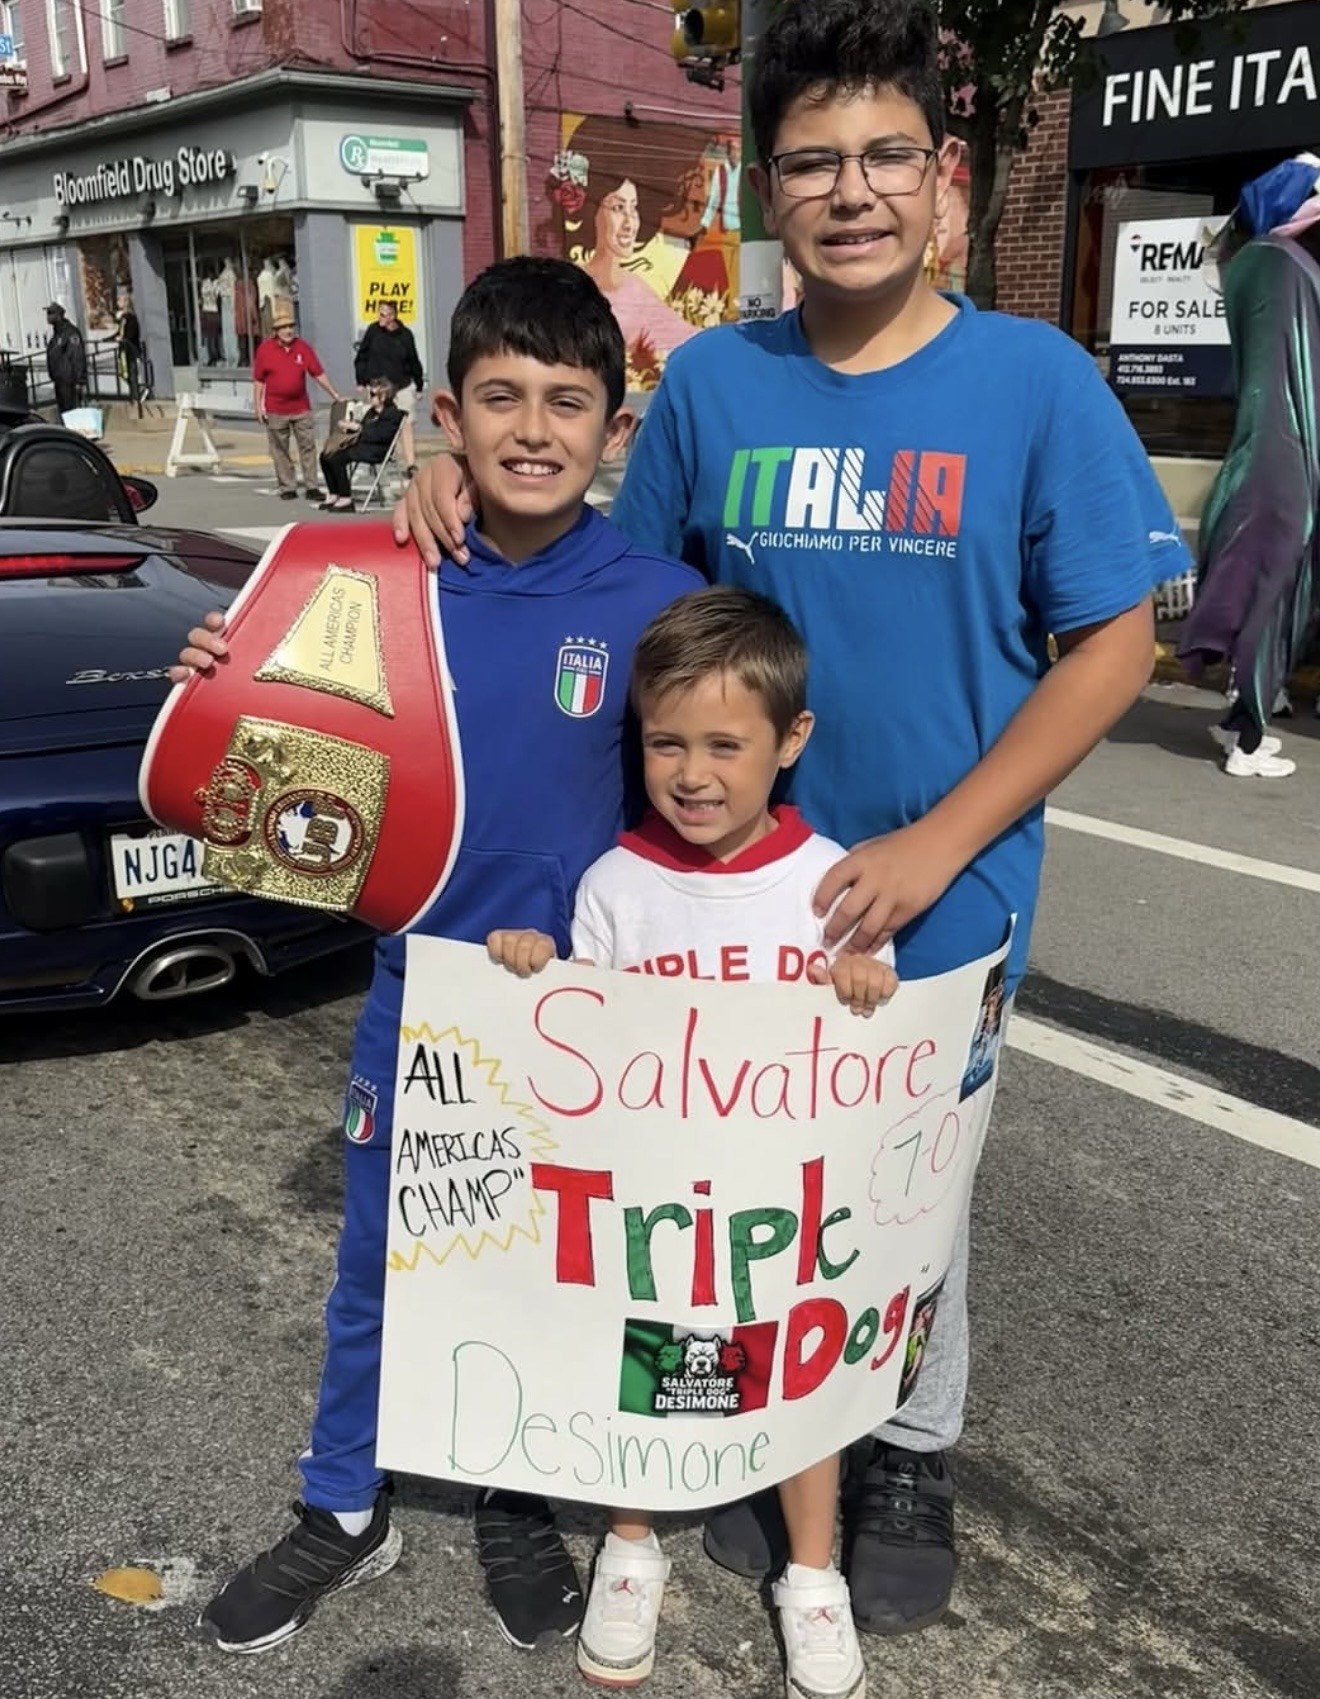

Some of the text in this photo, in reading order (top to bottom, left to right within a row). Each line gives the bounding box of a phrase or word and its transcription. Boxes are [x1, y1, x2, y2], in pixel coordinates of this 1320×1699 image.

[1103, 46, 1317, 127] FINE ITA
[54, 147, 225, 206] Bloomfield Drug Store
[369, 282, 410, 297] PLAY
[747, 297, 761, 308] NO
[1129, 300, 1226, 318] FOR SALE
[1163, 324, 1197, 335] UNITS
[723, 447, 967, 536] ITALIA
[759, 531, 957, 558] GIOCHIAMO PER VINCERE
[319, 587, 346, 673] ALL AMERICAS
[340, 600, 363, 664] CHAMPION
[563, 652, 602, 670] ITALIA
[124, 839, 204, 886] NJG4
[404, 1043, 476, 1105] ALL
[528, 986, 938, 1121] Salvatore
[396, 1126, 521, 1174] AMERICAS
[893, 1111, 960, 1197] 7-0
[654, 1393, 740, 1409] DESIMONE
[662, 1376, 734, 1388] SALVATORE
[449, 1341, 772, 1492] Desimone
